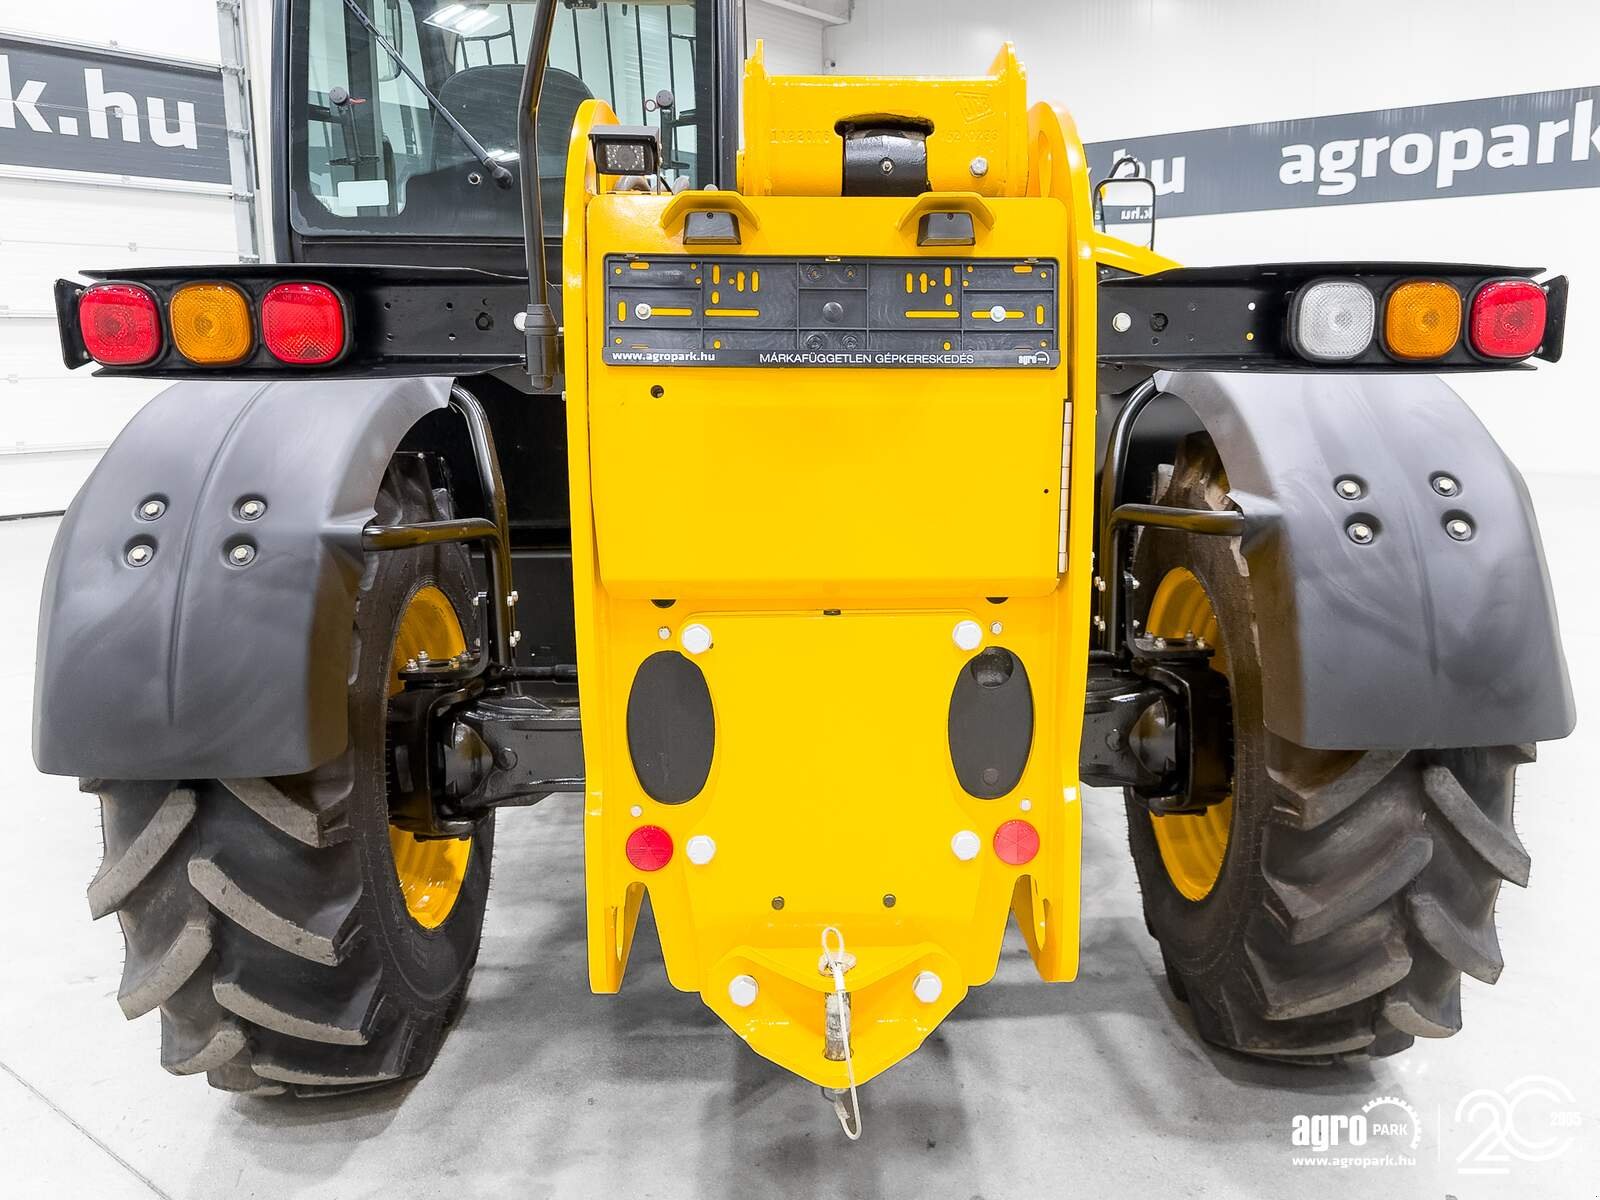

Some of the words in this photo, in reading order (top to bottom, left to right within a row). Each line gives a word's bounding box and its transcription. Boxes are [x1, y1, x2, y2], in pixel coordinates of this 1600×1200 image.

[612, 352, 716, 363] www.agropark.hu
[759, 352, 871, 364] MÁRKAFÜGGETLEN
[875, 353, 974, 364] GÉPKERESKEDÉS
